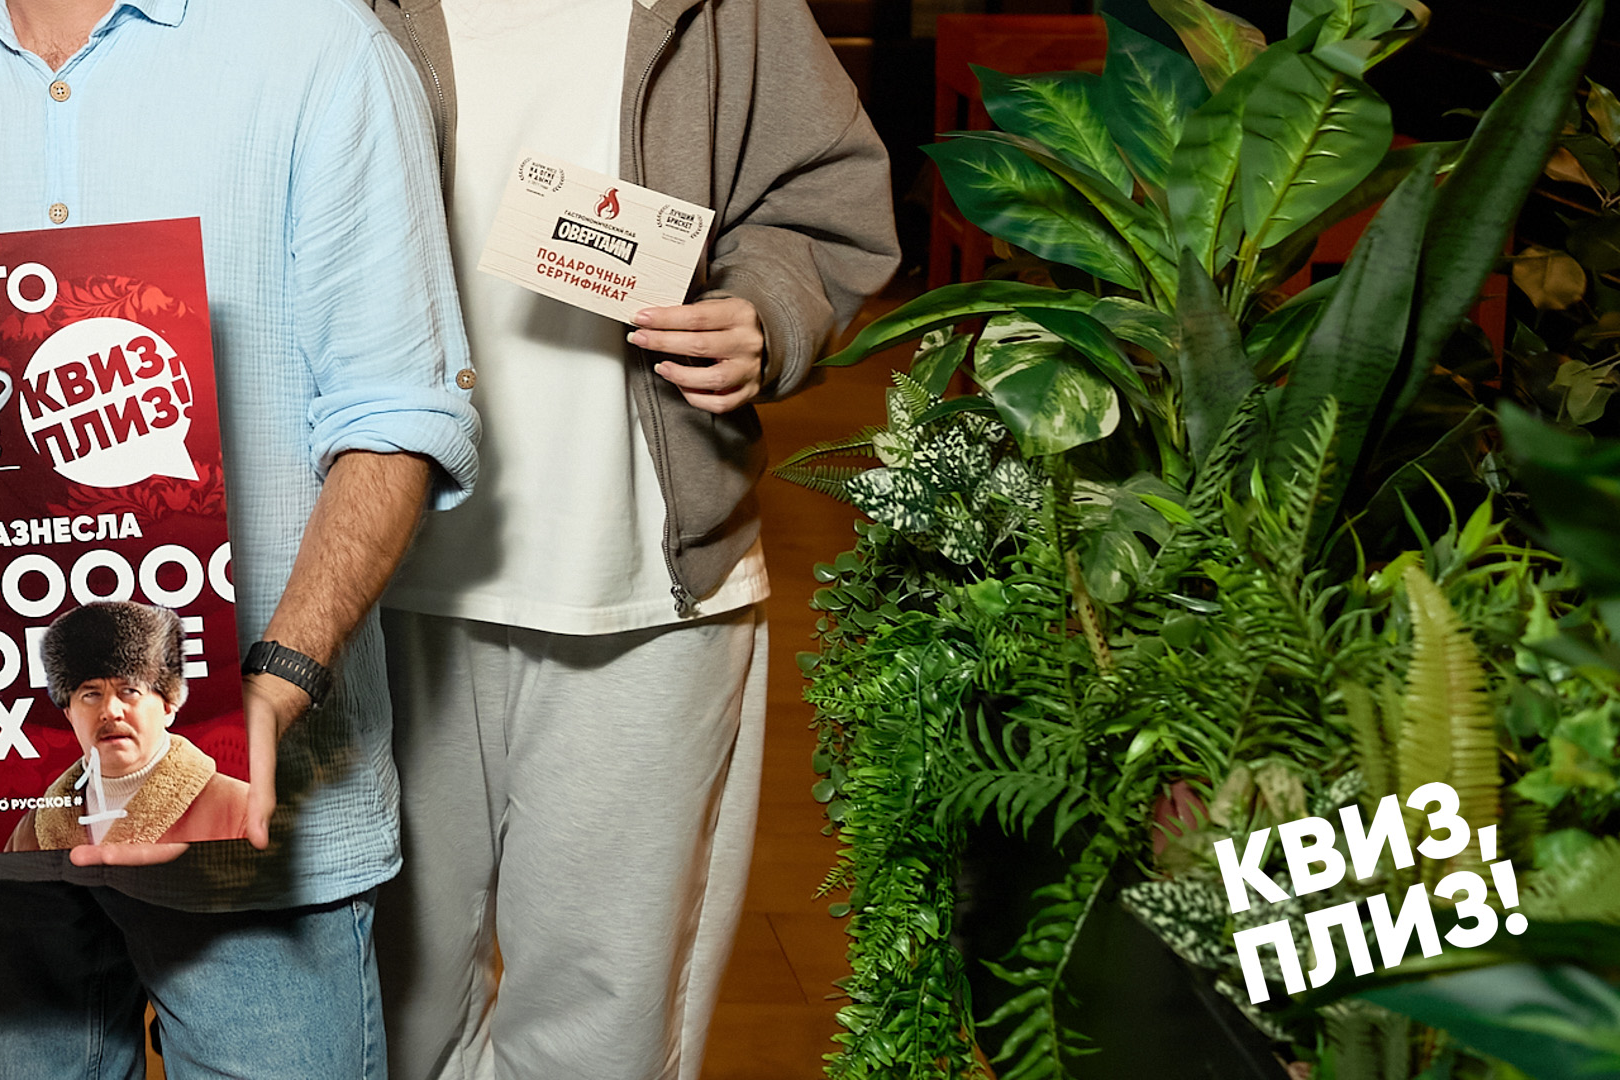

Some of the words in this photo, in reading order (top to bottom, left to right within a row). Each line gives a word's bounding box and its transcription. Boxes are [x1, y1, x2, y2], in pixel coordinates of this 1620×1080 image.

[537, 247, 637, 290] ПОДАРОЧНЫЙ
[537, 263, 628, 301] СЕРТИФИКАТ
[22, 336, 183, 420] КВИЗ,
[32, 377, 194, 465] ПЛИЗ!
[11, 795, 72, 811] РУССКОЕ
